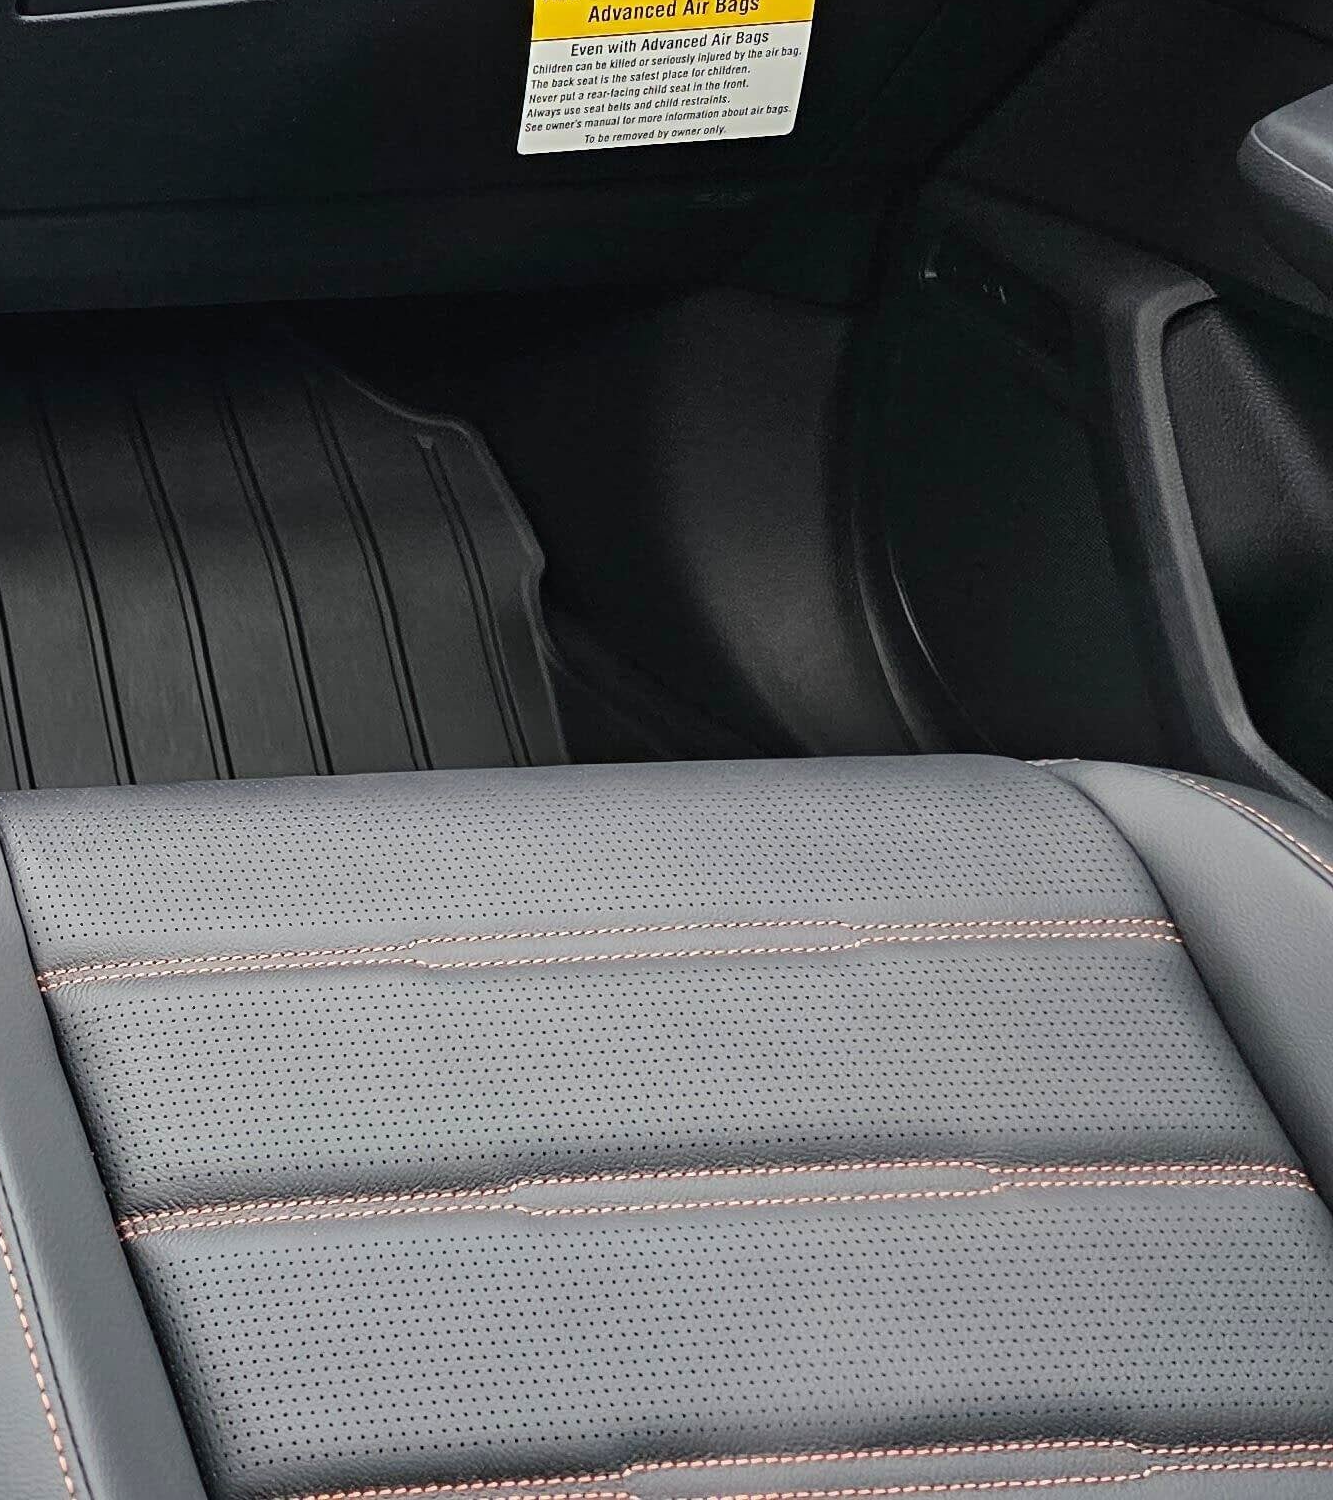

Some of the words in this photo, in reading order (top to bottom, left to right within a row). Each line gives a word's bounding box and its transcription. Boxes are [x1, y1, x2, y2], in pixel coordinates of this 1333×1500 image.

[587, 0, 677, 23] Advanced
[570, 43, 603, 57] Even
[607, 39, 636, 53] with
[640, 33, 708, 52] Advanced
[711, 32, 732, 47] Air
[735, 31, 770, 46] Bags
[533, 62, 573, 75] Children
[575, 62, 593, 72] can
[595, 60, 607, 70] be
[609, 58, 636, 69] killed
[639, 58, 649, 67] or
[651, 54, 695, 66] seriously
[697, 51, 732, 63] injured
[734, 50, 745, 61] by
[747, 49, 763, 59] the
[765, 47, 779, 57] air
[781, 47, 802, 58] bag.
[531, 80, 549, 89] The
[551, 77, 574, 88] back
[576, 75, 598, 86] seat
[600, 74, 609, 84] is
[612, 73, 627, 83] the
[629, 71, 659, 82] safest
[662, 70, 689, 81] place
[691, 67, 705, 78] for
[707, 65, 751, 76] children.
[528, 94, 558, 104] Never
[560, 91, 576, 103] put
[578, 92, 584, 101] a
[587, 88, 640, 100] rear-facing
[642, 84, 667, 95] child
[669, 83, 690, 93] seat
[693, 82, 703, 92] in
[705, 80, 720, 90] the
[723, 79, 749, 89] front.
[525, 122, 543, 132] See
[545, 119, 582, 131] owner's
[584, 116, 620, 128] manual
[622, 115, 636, 125] for
[637, 114, 663, 124] more
[665, 109, 719, 121] information
[721, 107, 749, 118] about
[750, 105, 764, 116] air
[766, 104, 792, 115] bags.
[527, 107, 561, 118] Always
[564, 106, 581, 115] use
[583, 104, 605, 114] seat
[607, 101, 631, 112] belts
[634, 100, 652, 110] and
[654, 98, 678, 108] child
[681, 95, 730, 107] restraints.
[585, 134, 595, 144] To
[597, 133, 610, 143] be
[612, 130, 654, 141] removed
[657, 129, 669, 140] by
[671, 127, 701, 137] owner
[703, 125, 727, 135] only.
